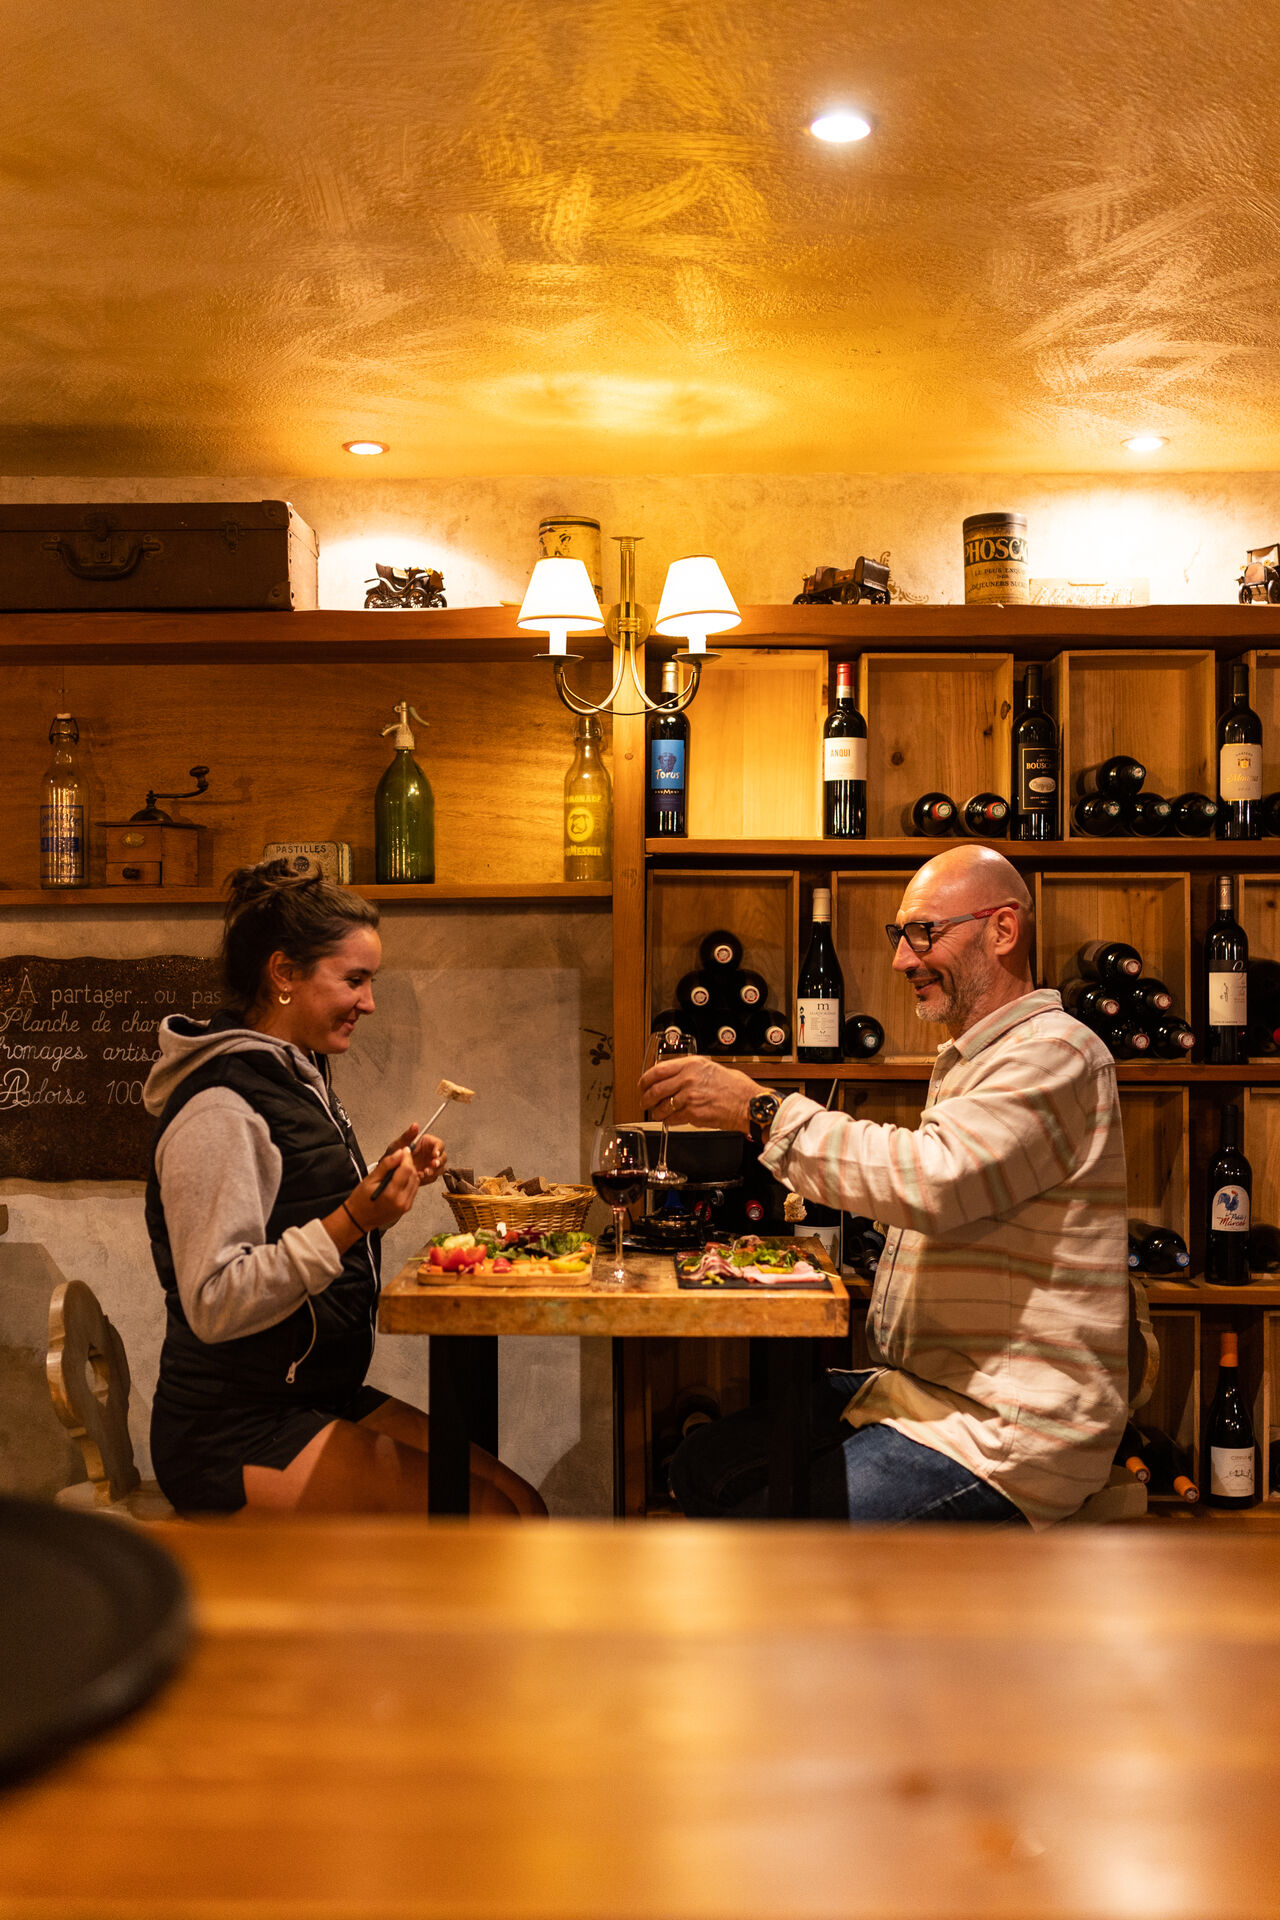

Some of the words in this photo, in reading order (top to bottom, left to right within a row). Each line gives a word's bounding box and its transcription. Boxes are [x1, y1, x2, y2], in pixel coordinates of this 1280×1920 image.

[964, 537, 1030, 563] PHOSCA
[654, 768, 680, 781] Torus
[1026, 762, 1050, 770] BOUSC
[276, 844, 327, 854] PASTILLES
[154, 989, 177, 1005] ou
[191, 990, 223, 1010] pas
[0, 1006, 81, 1033] Planche
[91, 1011, 112, 1033] de
[121, 1010, 160, 1033] char
[102, 1045, 162, 1064] artisa
